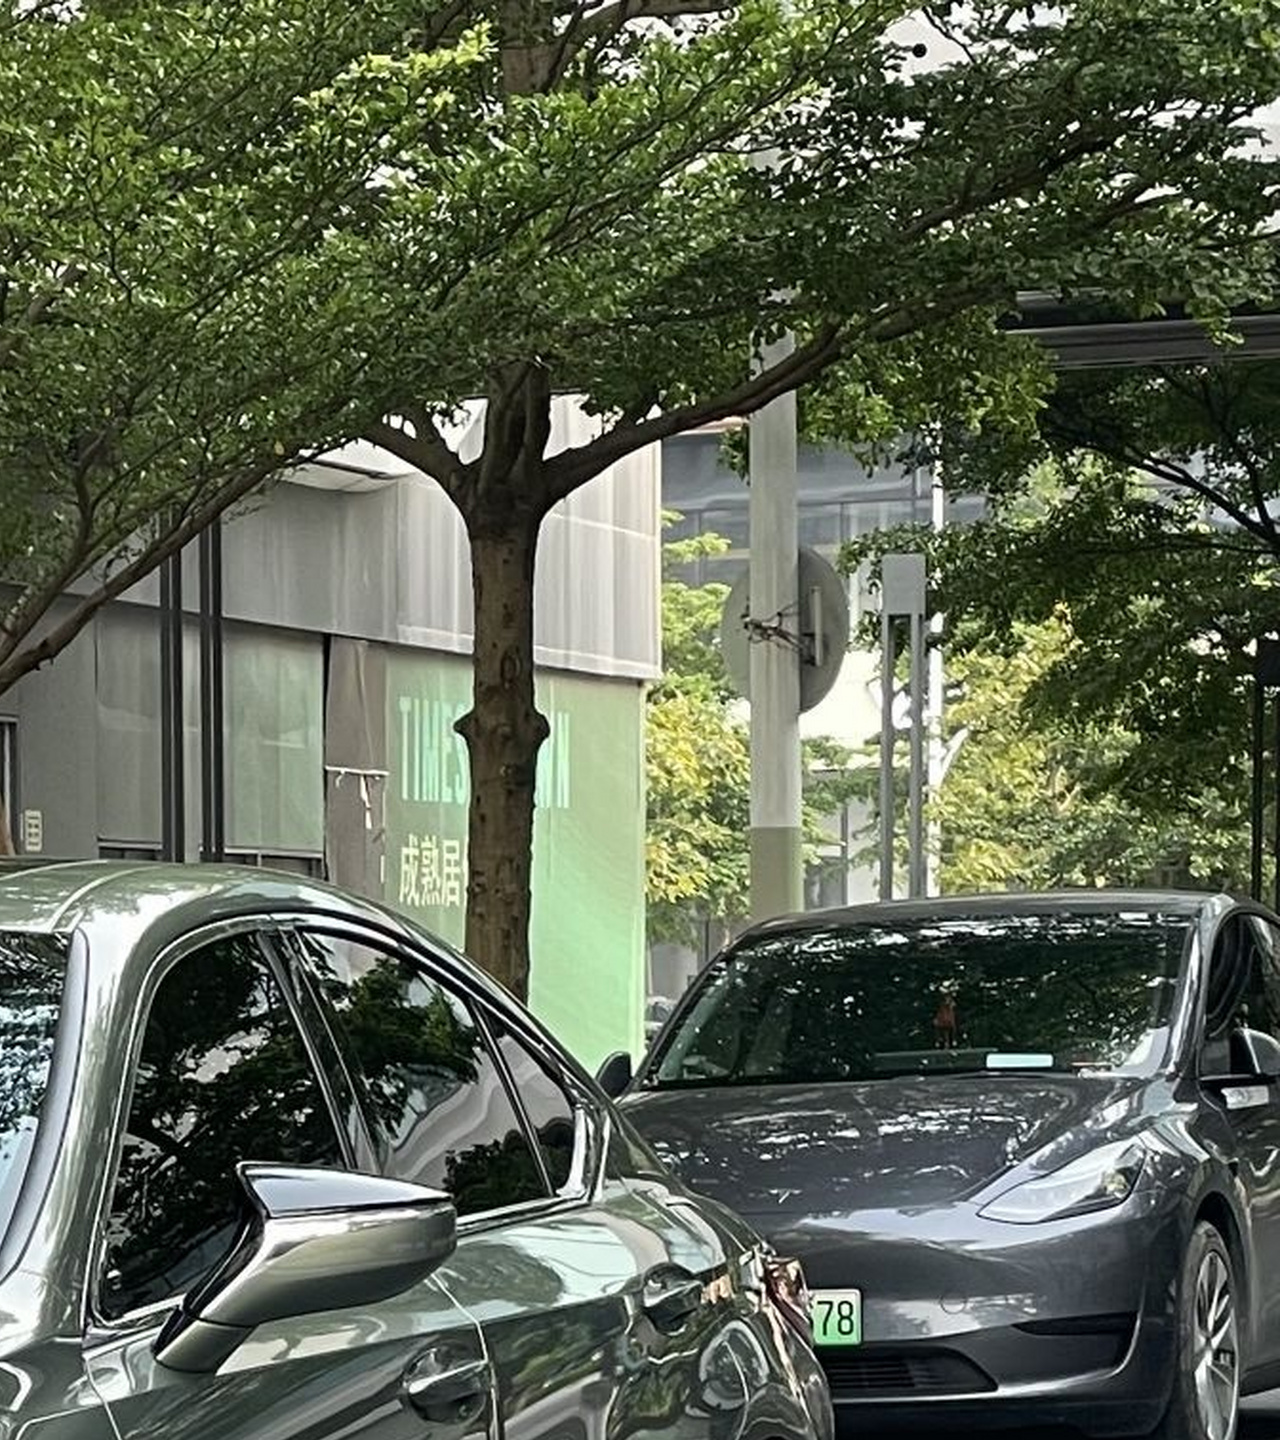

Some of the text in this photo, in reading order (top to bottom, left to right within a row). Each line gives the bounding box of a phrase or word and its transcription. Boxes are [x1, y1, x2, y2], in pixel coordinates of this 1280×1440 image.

[399, 834, 461, 907] 成熟居
[817, 1300, 854, 1336] 78
